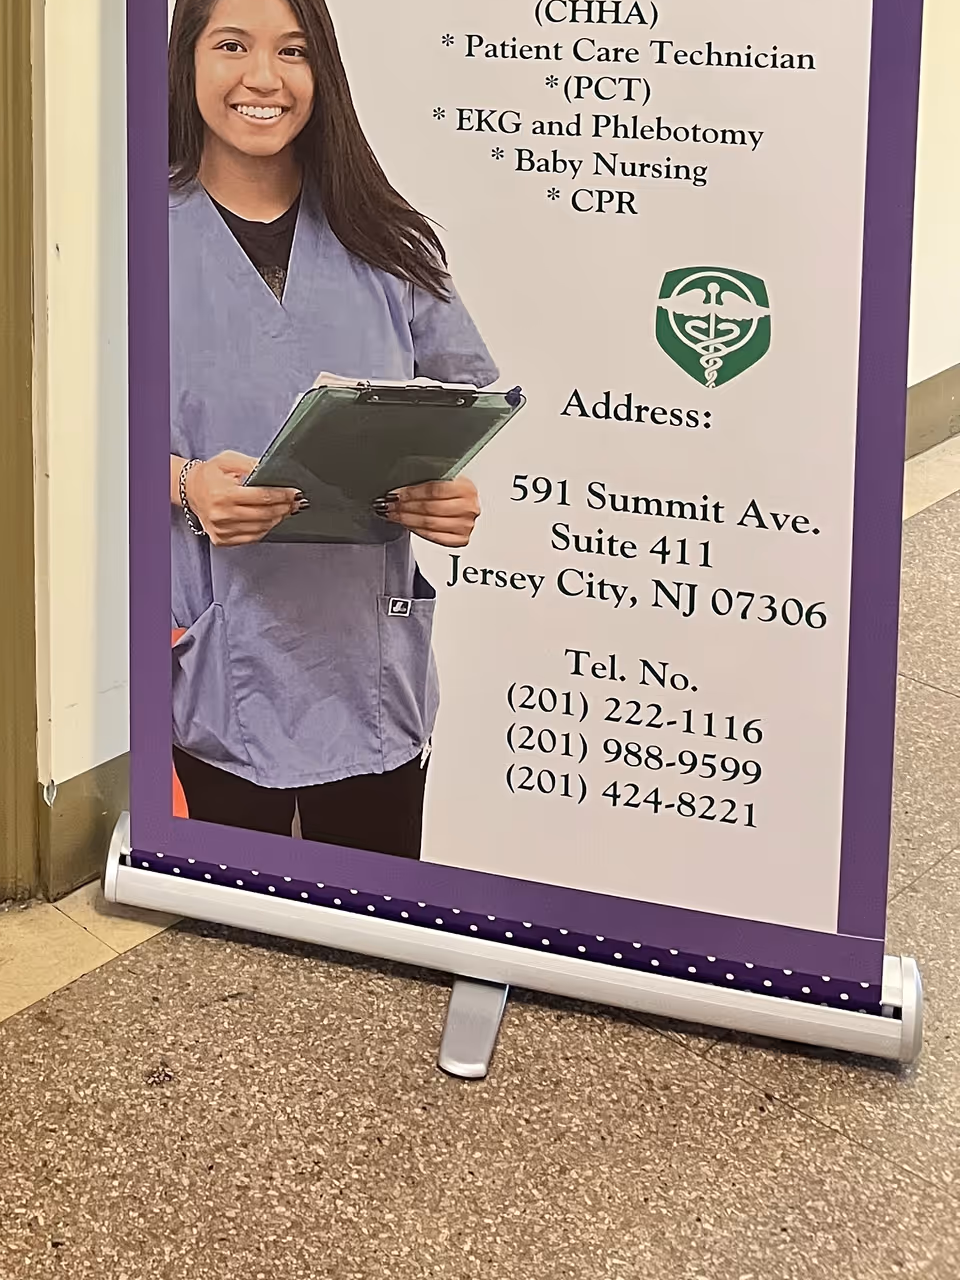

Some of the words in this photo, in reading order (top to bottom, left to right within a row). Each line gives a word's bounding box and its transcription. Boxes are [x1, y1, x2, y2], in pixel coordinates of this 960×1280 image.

[535, 0, 658, 29] (CHHA)
[465, 35, 562, 60] Patient
[573, 38, 639, 63] Care
[650, 40, 815, 69] Technician
[456, 108, 521, 133] EKG
[532, 113, 581, 136] and
[592, 115, 764, 151] Phlebotomy
[515, 148, 583, 179] Baby
[593, 152, 707, 186] Nursing
[572, 189, 638, 214] CPR
[561, 389, 711, 428] Address:
[511, 475, 570, 506] 591
[587, 482, 724, 523] Summit
[737, 499, 820, 534] Ave.
[552, 523, 636, 558] Suite
[650, 536, 712, 568] 411
[447, 554, 545, 598] Jersey
[558, 569, 637, 608] City,
[652, 579, 698, 617] NJ
[712, 589, 826, 628] 07306
[565, 649, 626, 681] Tel.
[639, 659, 697, 692] No.
[508, 683, 588, 722] (201)
[604, 698, 762, 743] 222-1116
[507, 723, 587, 763] (201)
[604, 739, 761, 784] 988-9599
[507, 764, 586, 804] (201)
[602, 781, 756, 828] 424-8221
